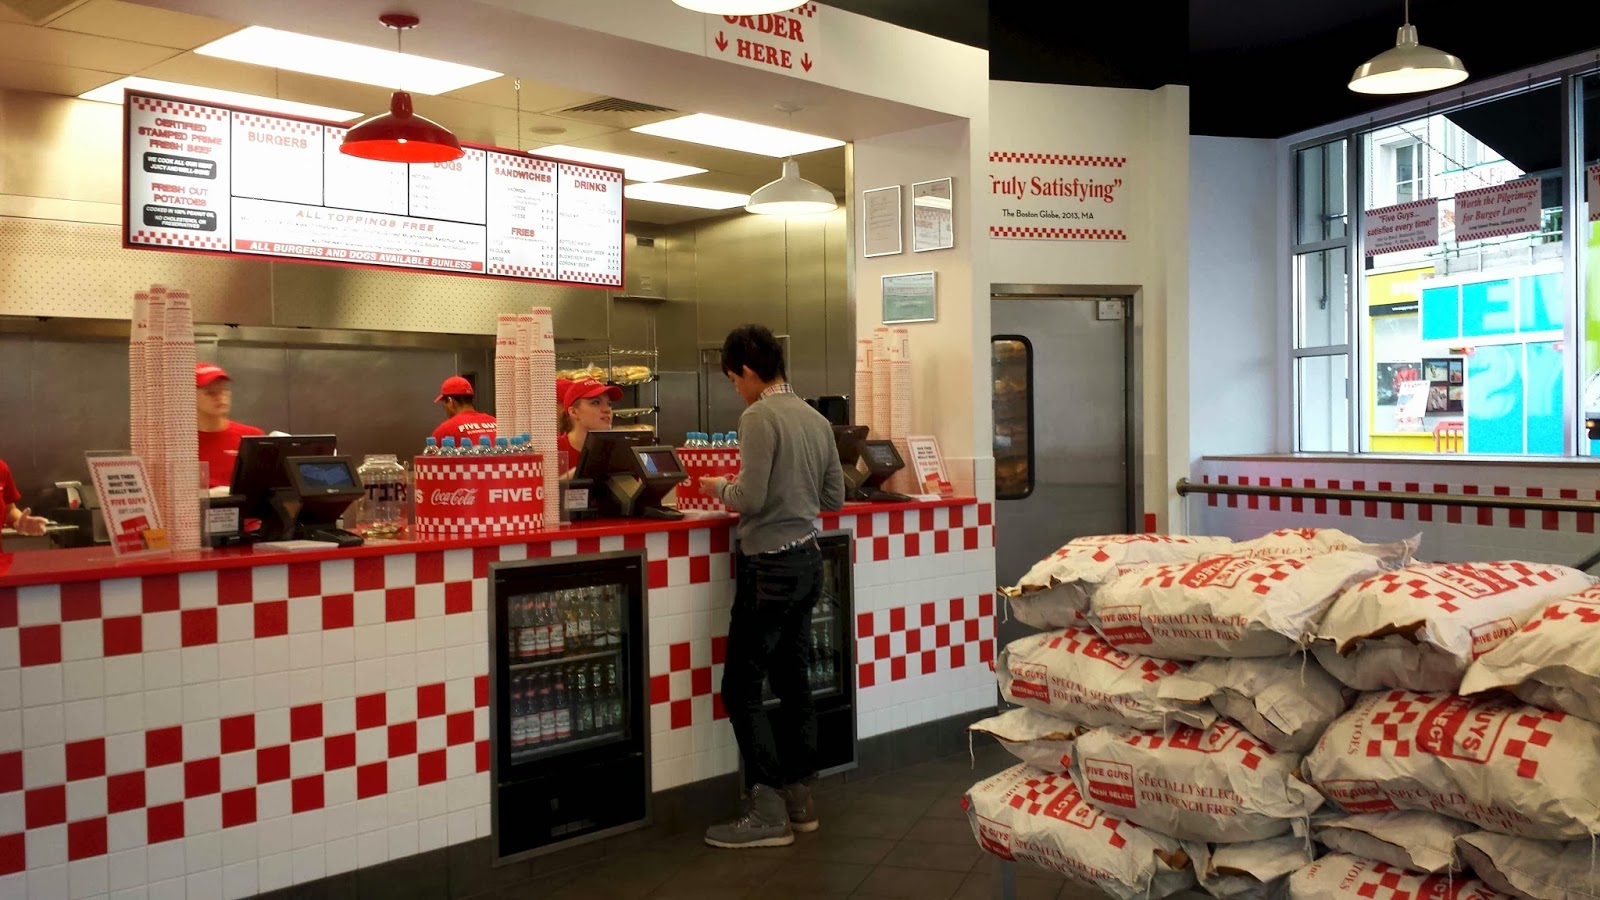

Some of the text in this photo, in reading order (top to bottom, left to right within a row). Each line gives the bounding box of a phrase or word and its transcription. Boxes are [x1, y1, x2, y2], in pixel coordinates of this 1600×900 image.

[737, 38, 792, 69] HERE
[155, 118, 207, 132] CERTIFIED
[138, 126, 222, 145] STAMPED PRIME
[248, 131, 307, 149] BURGERS
[150, 139, 183, 151] FRESH
[433, 161, 463, 171] DOGS
[494, 167, 551, 183] SANDWICHES
[151, 182, 208, 196] FRESH CUT
[574, 179, 607, 193] DRINKS
[989, 175, 1027, 200] ruly
[154, 193, 206, 206] POTATOES
[1483, 196, 1494, 206] the
[1497, 189, 1538, 204] Pilgrimage
[295, 209, 321, 219] ALL
[328, 213, 396, 228] TOPPINGS
[402, 221, 435, 232] FREE
[1002, 209, 1015, 217] The
[1016, 209, 1038, 218] Boston
[1039, 210, 1061, 219] Globe,
[1062, 212, 1080, 220] 2013,
[1397, 211, 1420, 221] Guys...
[1462, 212, 1473, 225] for
[1475, 210, 1501, 221] Burger
[511, 227, 535, 238] FRIES
[1367, 225, 1393, 236] satisfies
[1395, 222, 1413, 232] every
[249, 241, 271, 251] ALL
[273, 244, 323, 255] BURGERS
[326, 248, 347, 258] AND
[349, 250, 376, 261] DOGS
[378, 253, 429, 266] AVAILABLE
[431, 258, 472, 269] BUNLESS
[458, 422, 481, 432] FIVE
[364, 482, 407, 502] TIPS
[431, 488, 478, 506] Coca-Cola
[489, 487, 532, 503] FIVE
[110, 497, 147, 506] FIVE GUYS
[1117, 613, 1138, 621] GUYS
[1147, 614, 1198, 625] SPECIALLY
[1152, 627, 1170, 636] FOR
[1173, 628, 1213, 639] FRENCH
[1473, 633, 1490, 646] FIVE
[1025, 669, 1045, 680] GUYS
[1087, 766, 1129, 780] FIVE GUYS
[1138, 776, 1195, 796] SPECIALLY
[1109, 791, 1133, 801] SELECT
[1140, 791, 1238, 816] FOR FRENCH FRIES
[988, 828, 1009, 841] GUYS
